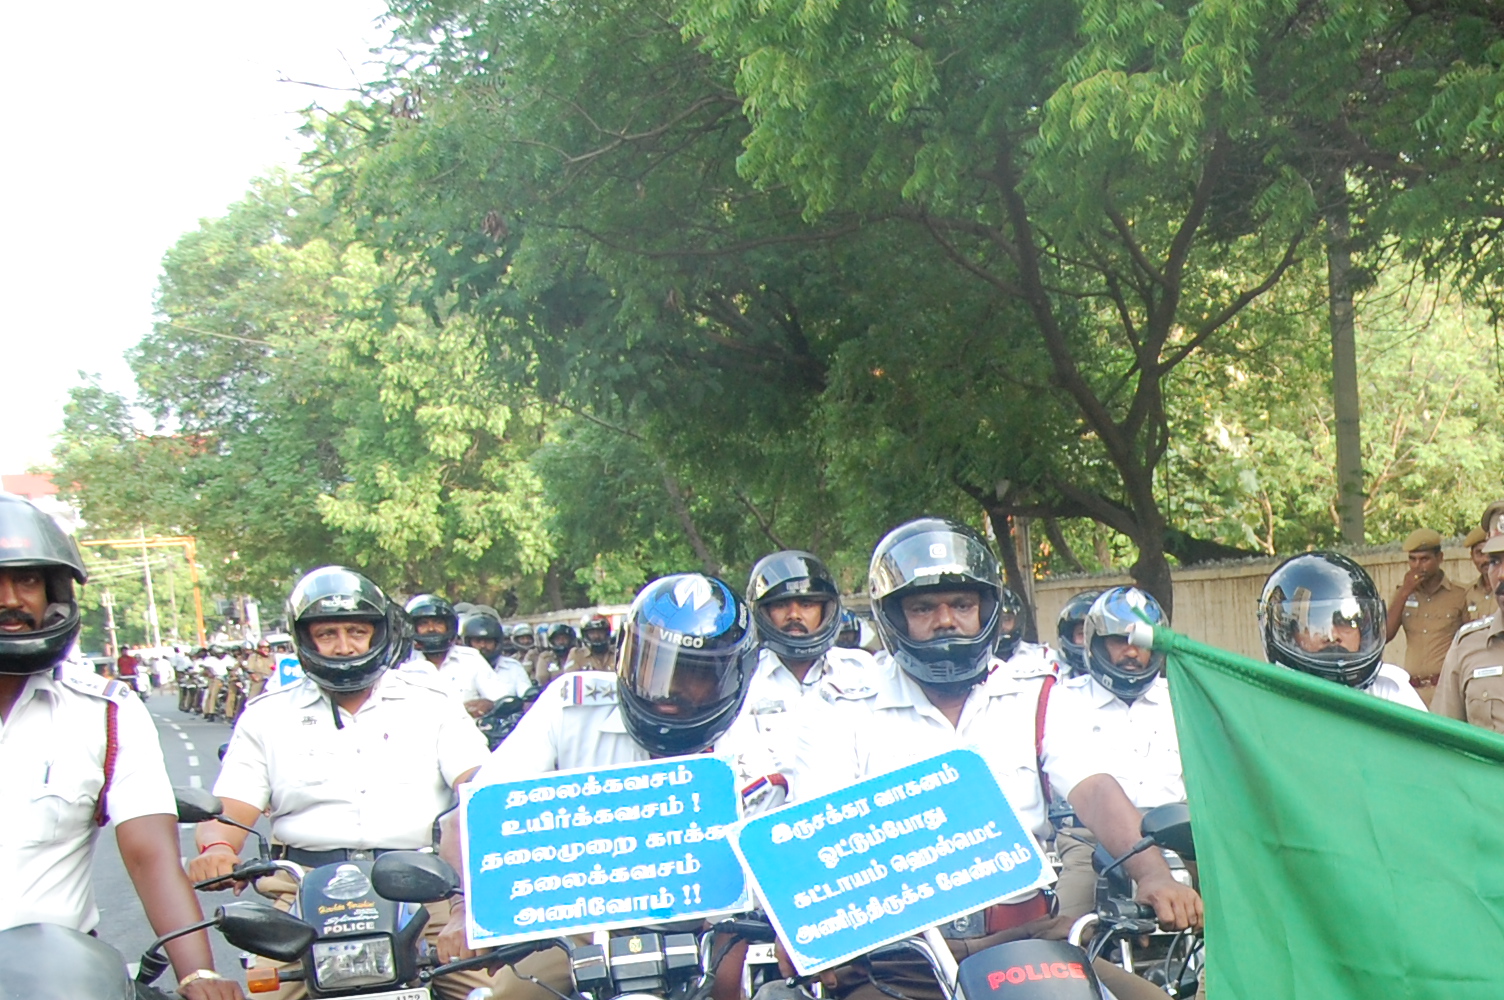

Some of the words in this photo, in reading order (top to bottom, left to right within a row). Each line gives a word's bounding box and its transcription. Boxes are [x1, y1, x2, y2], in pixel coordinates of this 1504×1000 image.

[660, 629, 704, 648] VIRGO
[505, 765, 693, 809] தலைக்கவசம்
[771, 802, 871, 844] இருசக்கர
[873, 763, 960, 808] வாகனம்
[501, 795, 684, 836] உயிர்க்கவசம்
[480, 835, 638, 873] தலைமுறை
[817, 806, 948, 869] ஓட்டும்போது
[510, 853, 701, 900] தலைக்கவசம்
[793, 859, 888, 909] கட்டாயம்
[890, 820, 1002, 873] ஹெல்மெட்
[513, 887, 675, 926] அணிவோம்
[795, 883, 935, 944] அணிந்திருக்க
[935, 843, 1032, 891] வேண்டும்
[323, 921, 375, 935] POLICE
[987, 962, 1087, 990] POLICE
